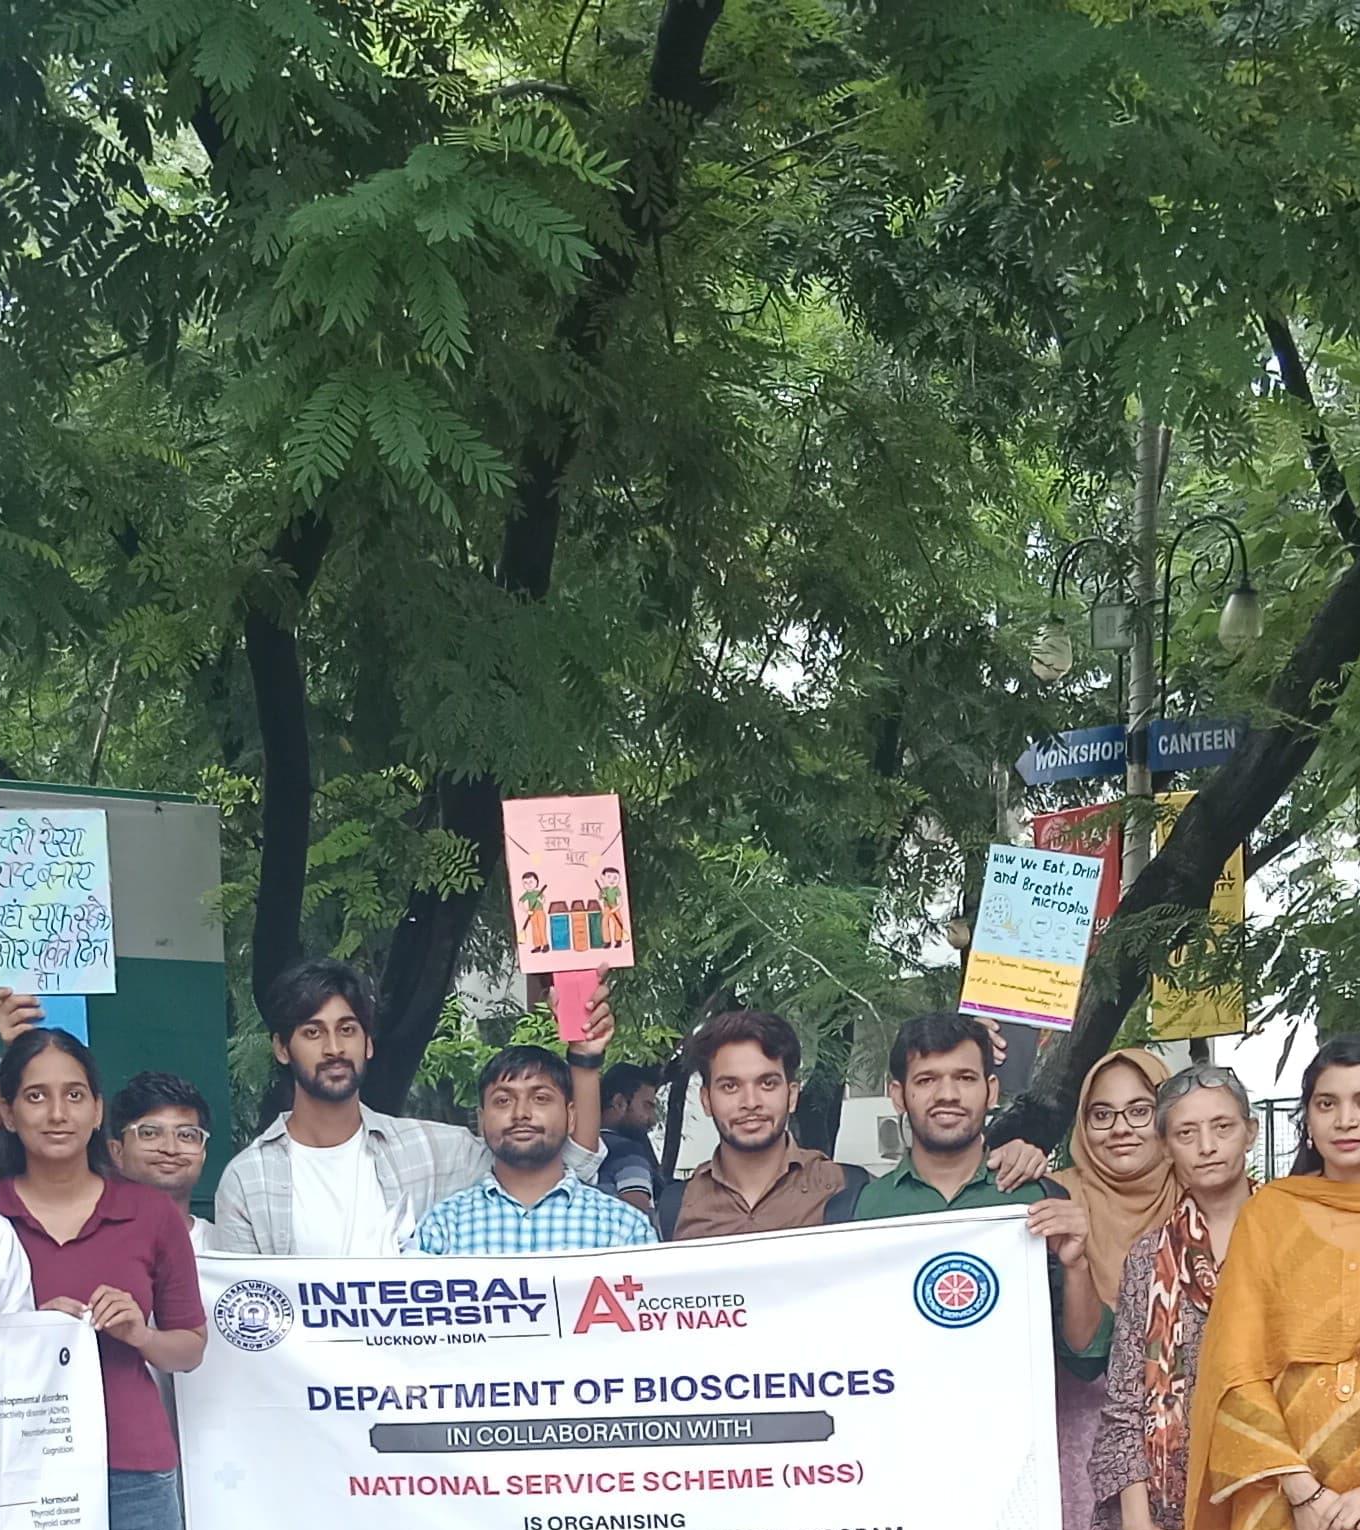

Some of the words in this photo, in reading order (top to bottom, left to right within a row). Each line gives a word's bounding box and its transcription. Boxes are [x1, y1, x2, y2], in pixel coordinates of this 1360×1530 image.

[1158, 728, 1236, 755] CANTEEN
[1035, 742, 1124, 771] WORKSHOP
[1021, 858, 1037, 869] We
[993, 871, 1018, 885] and
[1022, 877, 1073, 896] Breathe
[298, 1277, 546, 1305] INTEGRAL
[637, 1294, 745, 1311] ACCREDITED
[302, 1302, 546, 1328] UNIVERSITY
[638, 1313, 669, 1332] BY
[677, 1308, 748, 1330] NAAC
[307, 1379, 565, 1411] DEPARTMENT
[574, 1377, 625, 1405] OF
[634, 1368, 896, 1403] BIOSCIENCES
[446, 1427, 470, 1446] IN
[476, 1419, 684, 1445] COLLABORATION
[686, 1418, 753, 1440] WITH
[347, 1473, 501, 1498] NATIONAL
[506, 1471, 636, 1496] SERVICE
[641, 1466, 774, 1494] SCHEME
[782, 1462, 865, 1491] (NSS)
